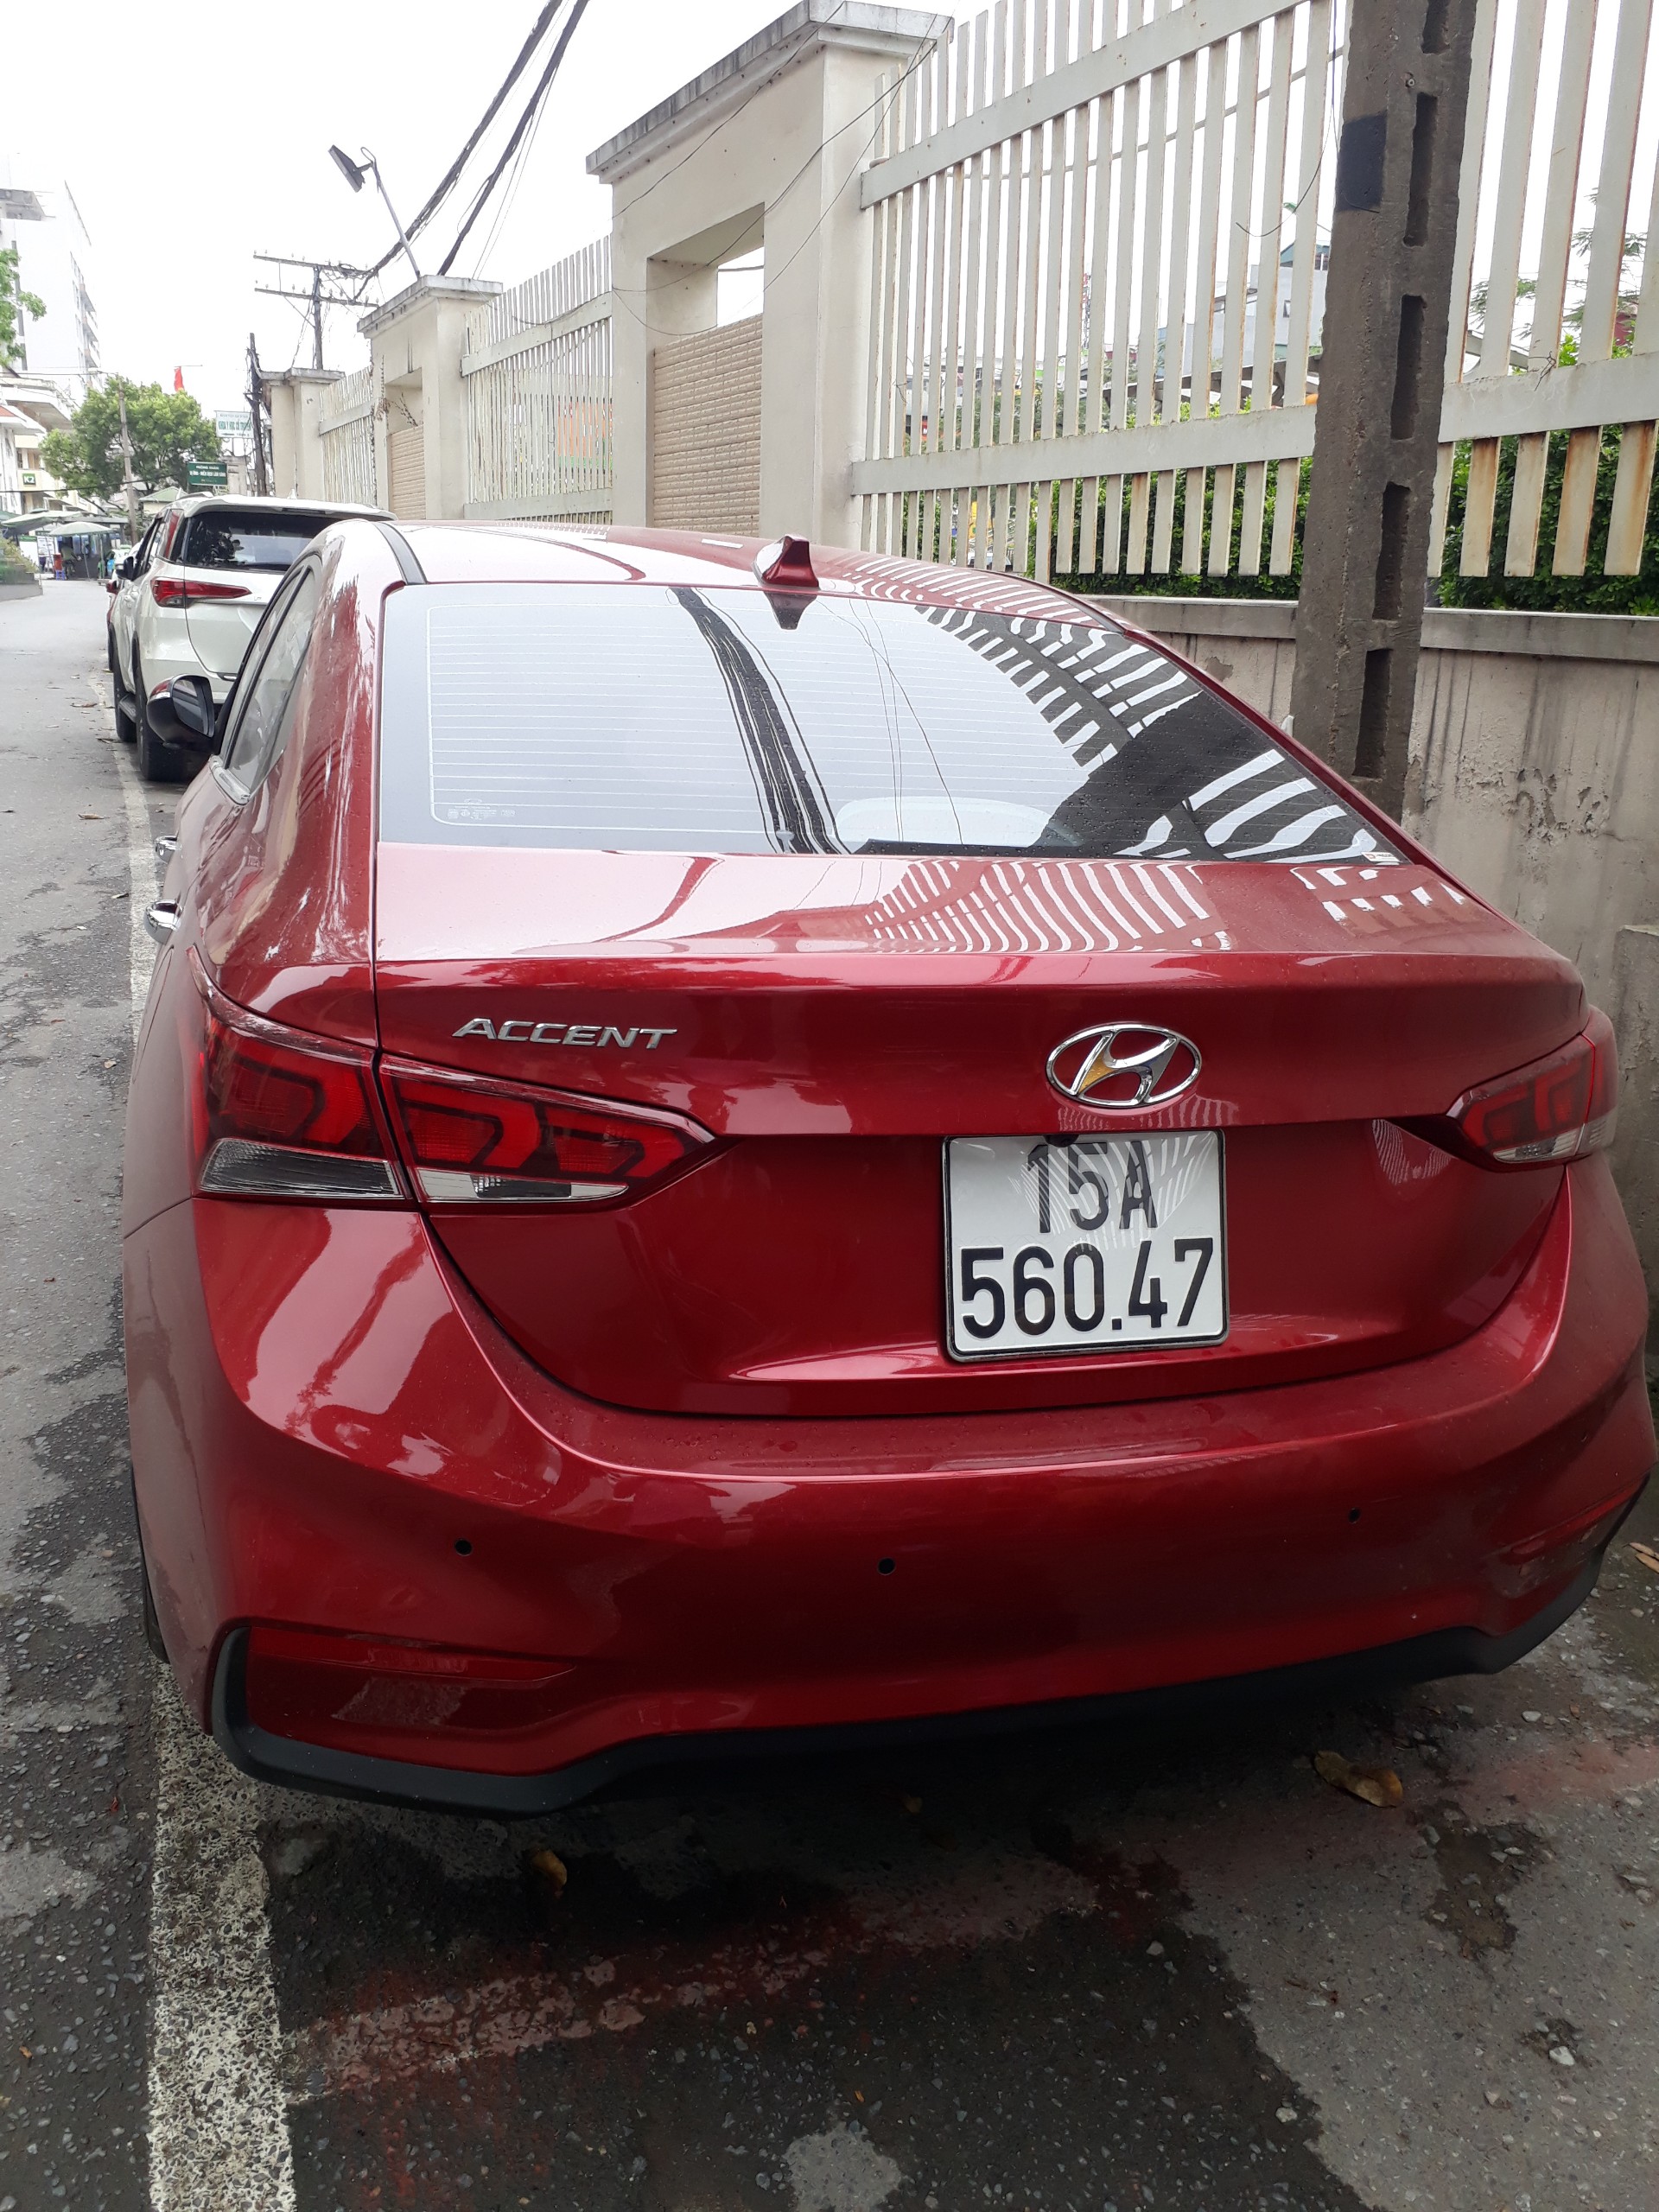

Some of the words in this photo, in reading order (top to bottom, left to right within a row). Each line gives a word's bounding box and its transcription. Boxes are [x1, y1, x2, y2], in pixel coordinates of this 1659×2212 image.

[451, 1017, 678, 1049] ACCENT
[1027, 1141, 1159, 1234] 15A
[960, 1236, 1215, 1340] 560.47
